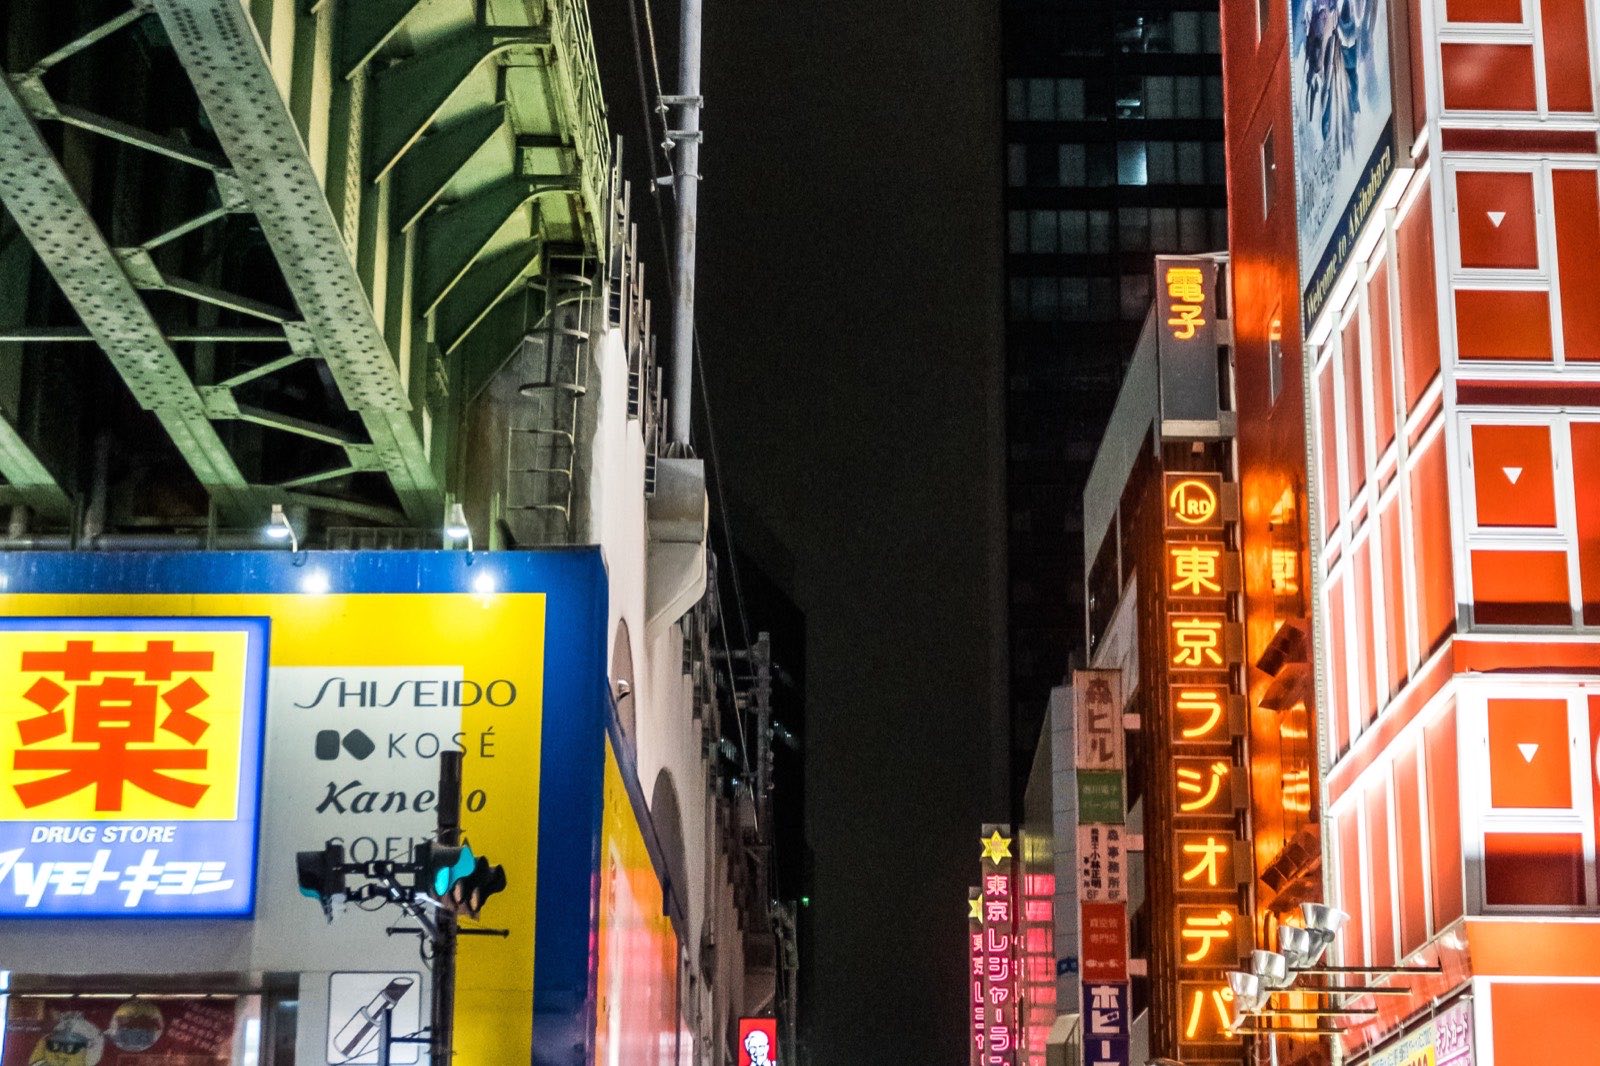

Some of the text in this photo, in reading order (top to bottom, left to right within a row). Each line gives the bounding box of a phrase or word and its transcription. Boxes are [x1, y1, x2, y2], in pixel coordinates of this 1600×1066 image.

[1306, 145, 1391, 323] Welcome to Akihabara
[1166, 267, 1206, 340] 電子
[293, 676, 517, 709] SHISEIDO
[12, 640, 214, 812] 薬
[387, 726, 496, 759] KOSÉ
[315, 779, 487, 815] Kaneo
[30, 825, 177, 844] DRUG STORE
[1091, 985, 1120, 1066] ホビー
